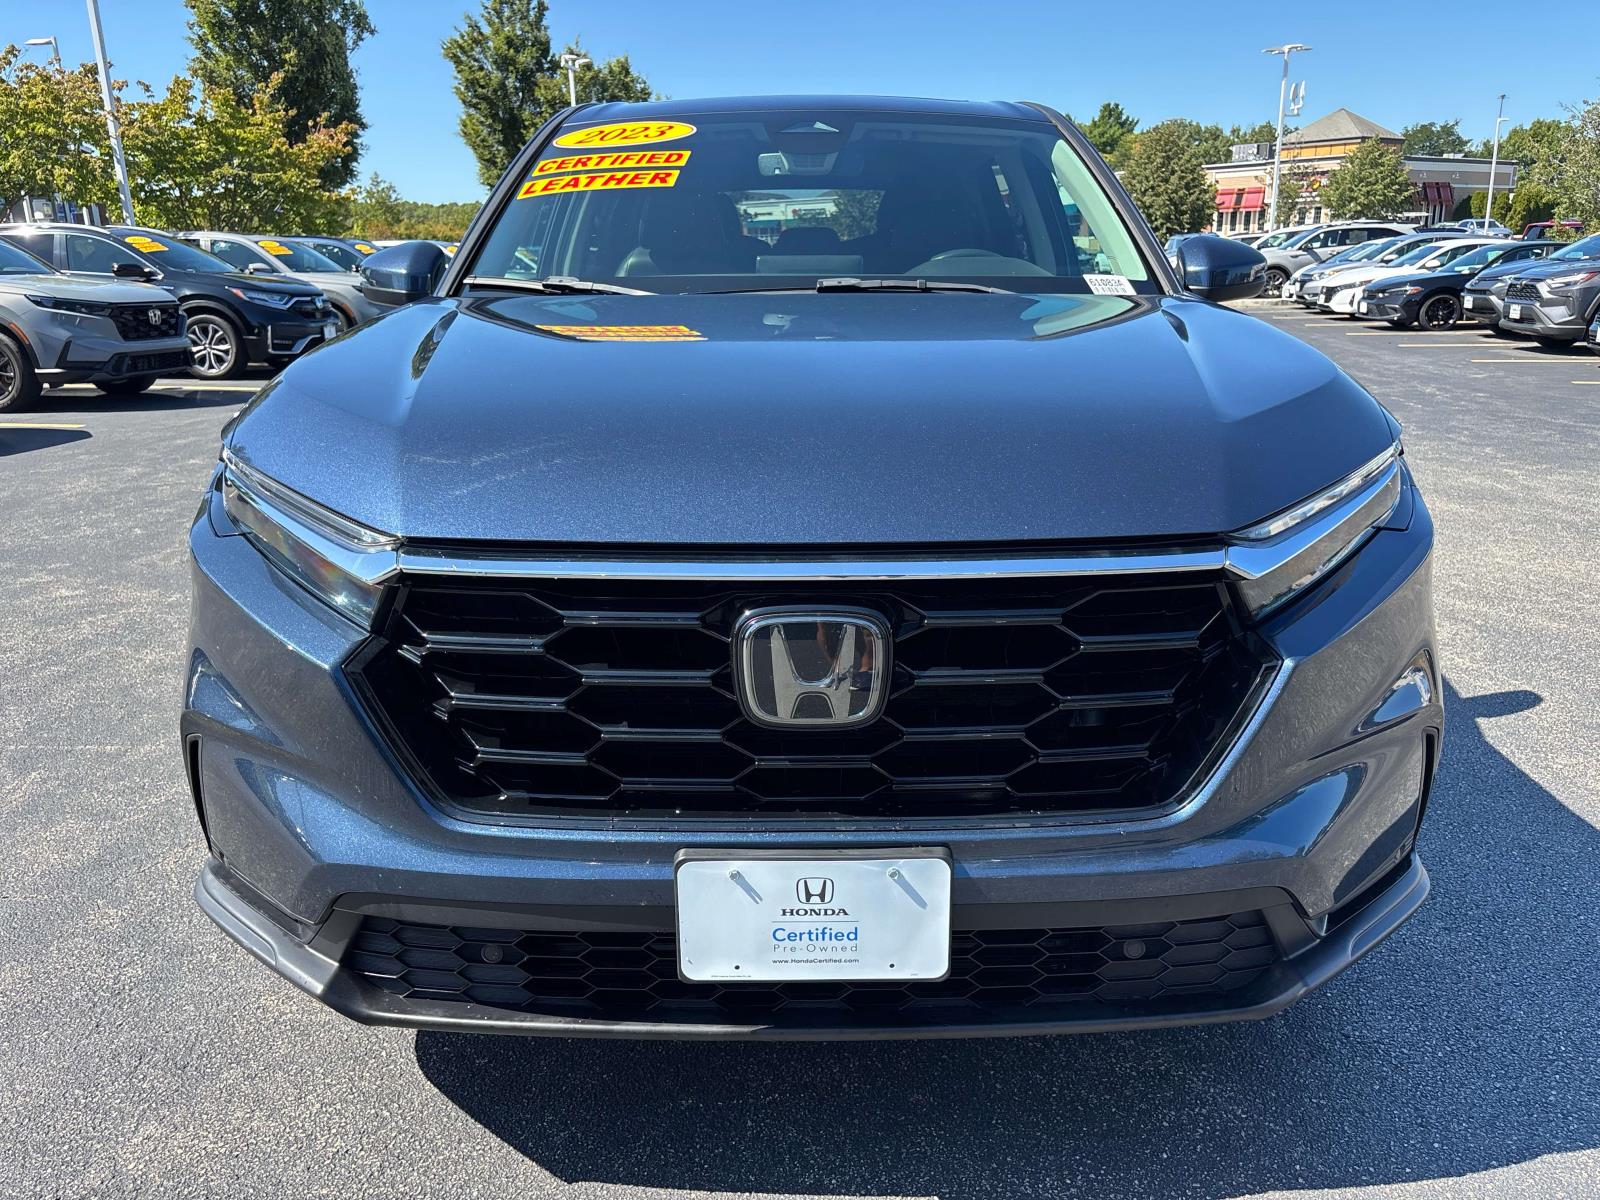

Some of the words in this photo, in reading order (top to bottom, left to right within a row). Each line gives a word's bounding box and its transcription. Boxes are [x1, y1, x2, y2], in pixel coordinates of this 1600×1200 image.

[575, 125, 675, 145] 2023
[537, 152, 684, 173] CERTIFIED
[522, 172, 673, 195] LEATHER
[781, 908, 850, 916] HONDA
[772, 926, 858, 942] Certified
[773, 943, 858, 953] Pre-Owned
